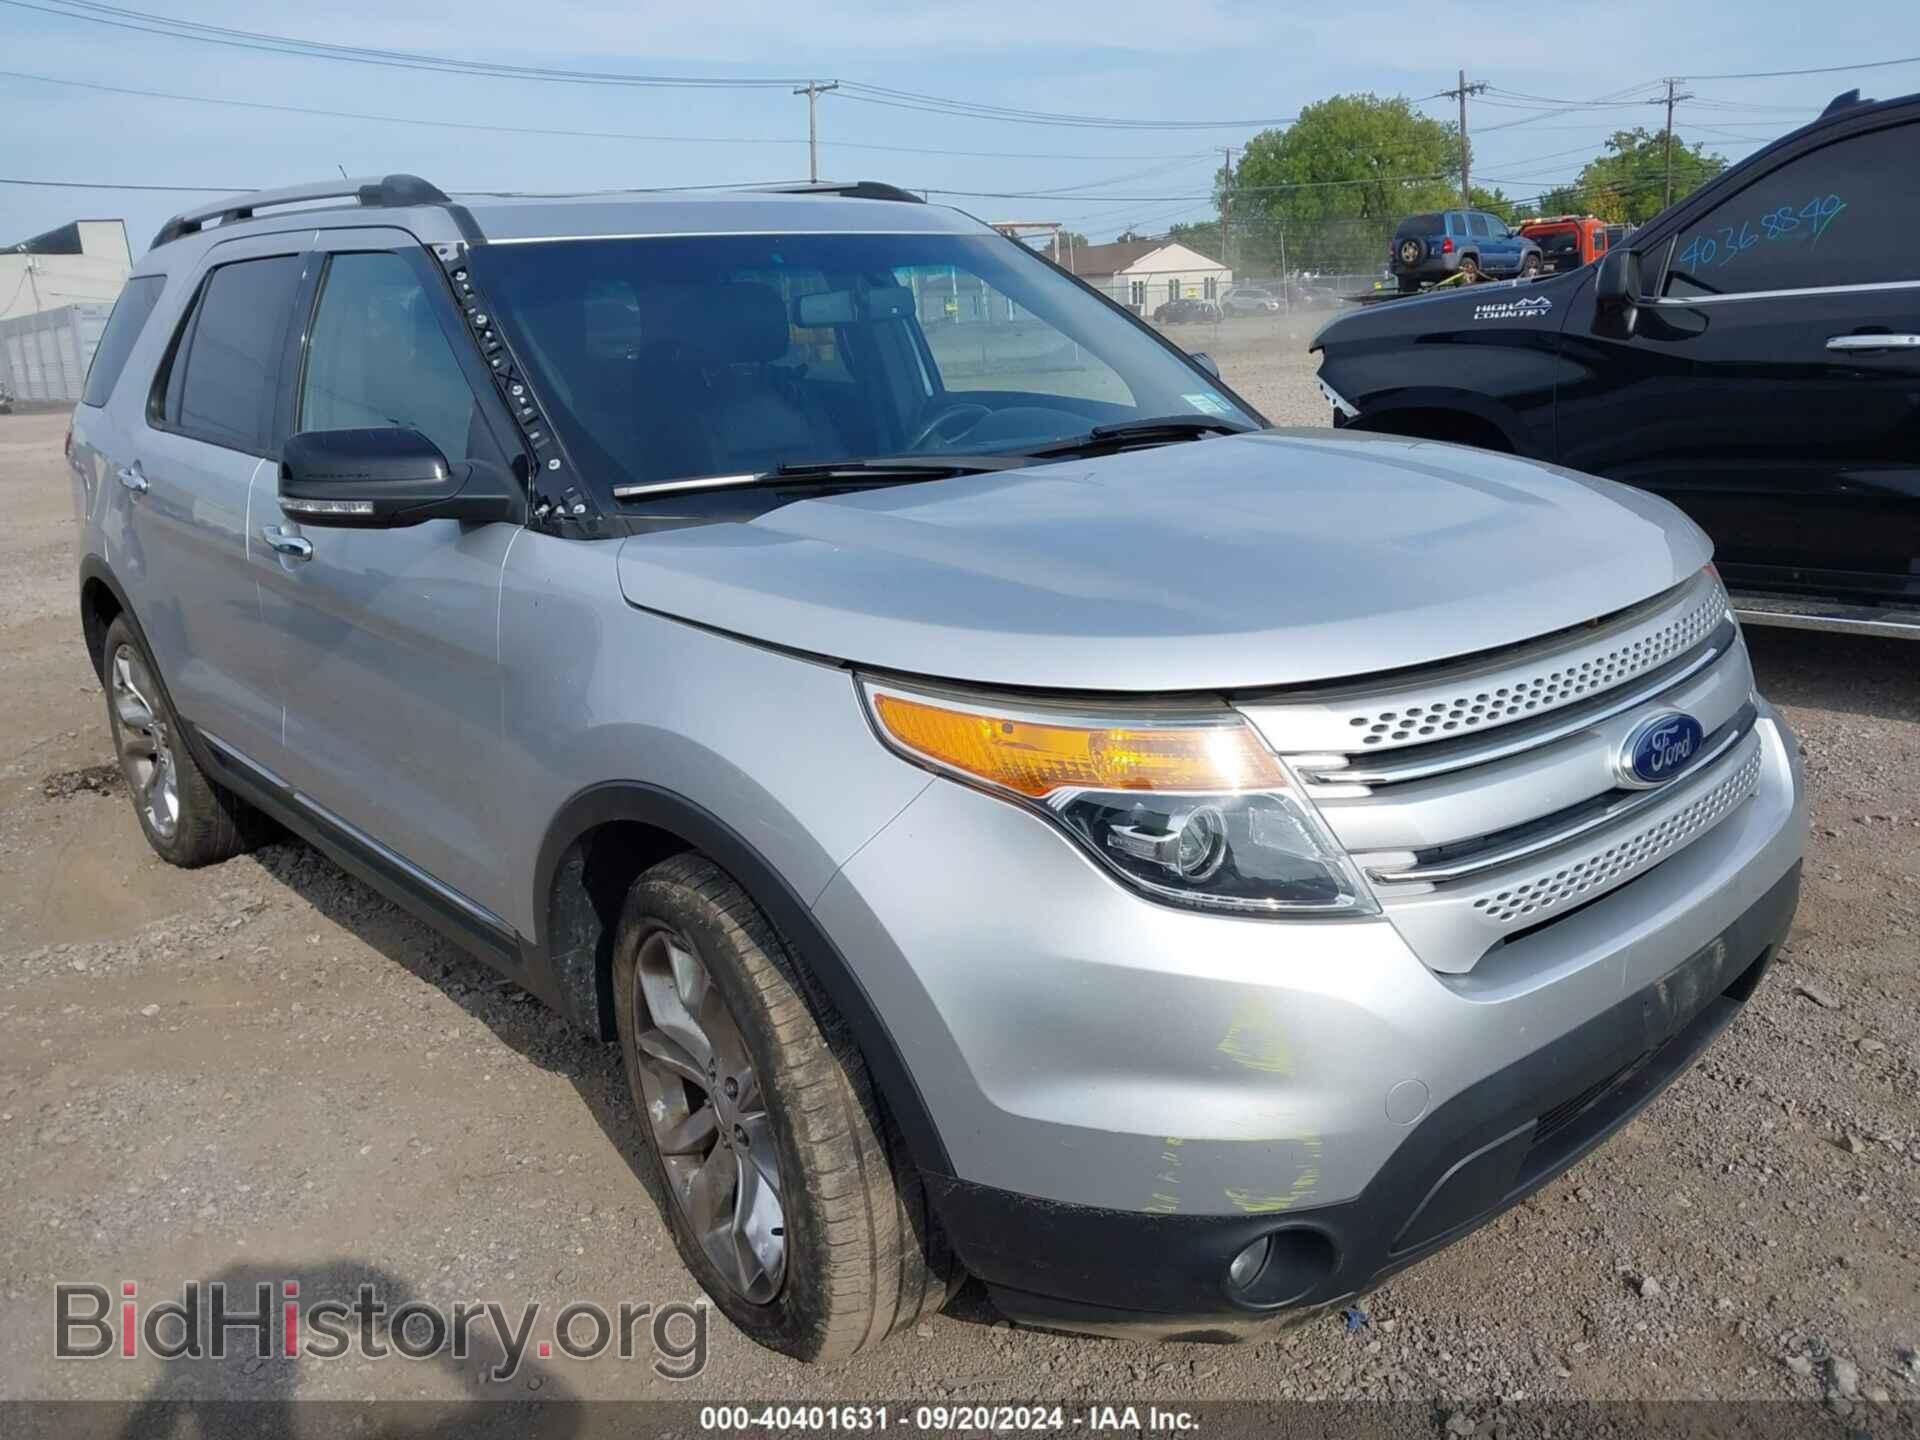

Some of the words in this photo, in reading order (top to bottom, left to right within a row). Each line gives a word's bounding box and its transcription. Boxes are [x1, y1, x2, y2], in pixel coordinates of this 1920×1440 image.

[1475, 303, 1514, 312] HIGH
[1473, 308, 1550, 320] COUNTRY
[1651, 725, 1691, 772] Ford
